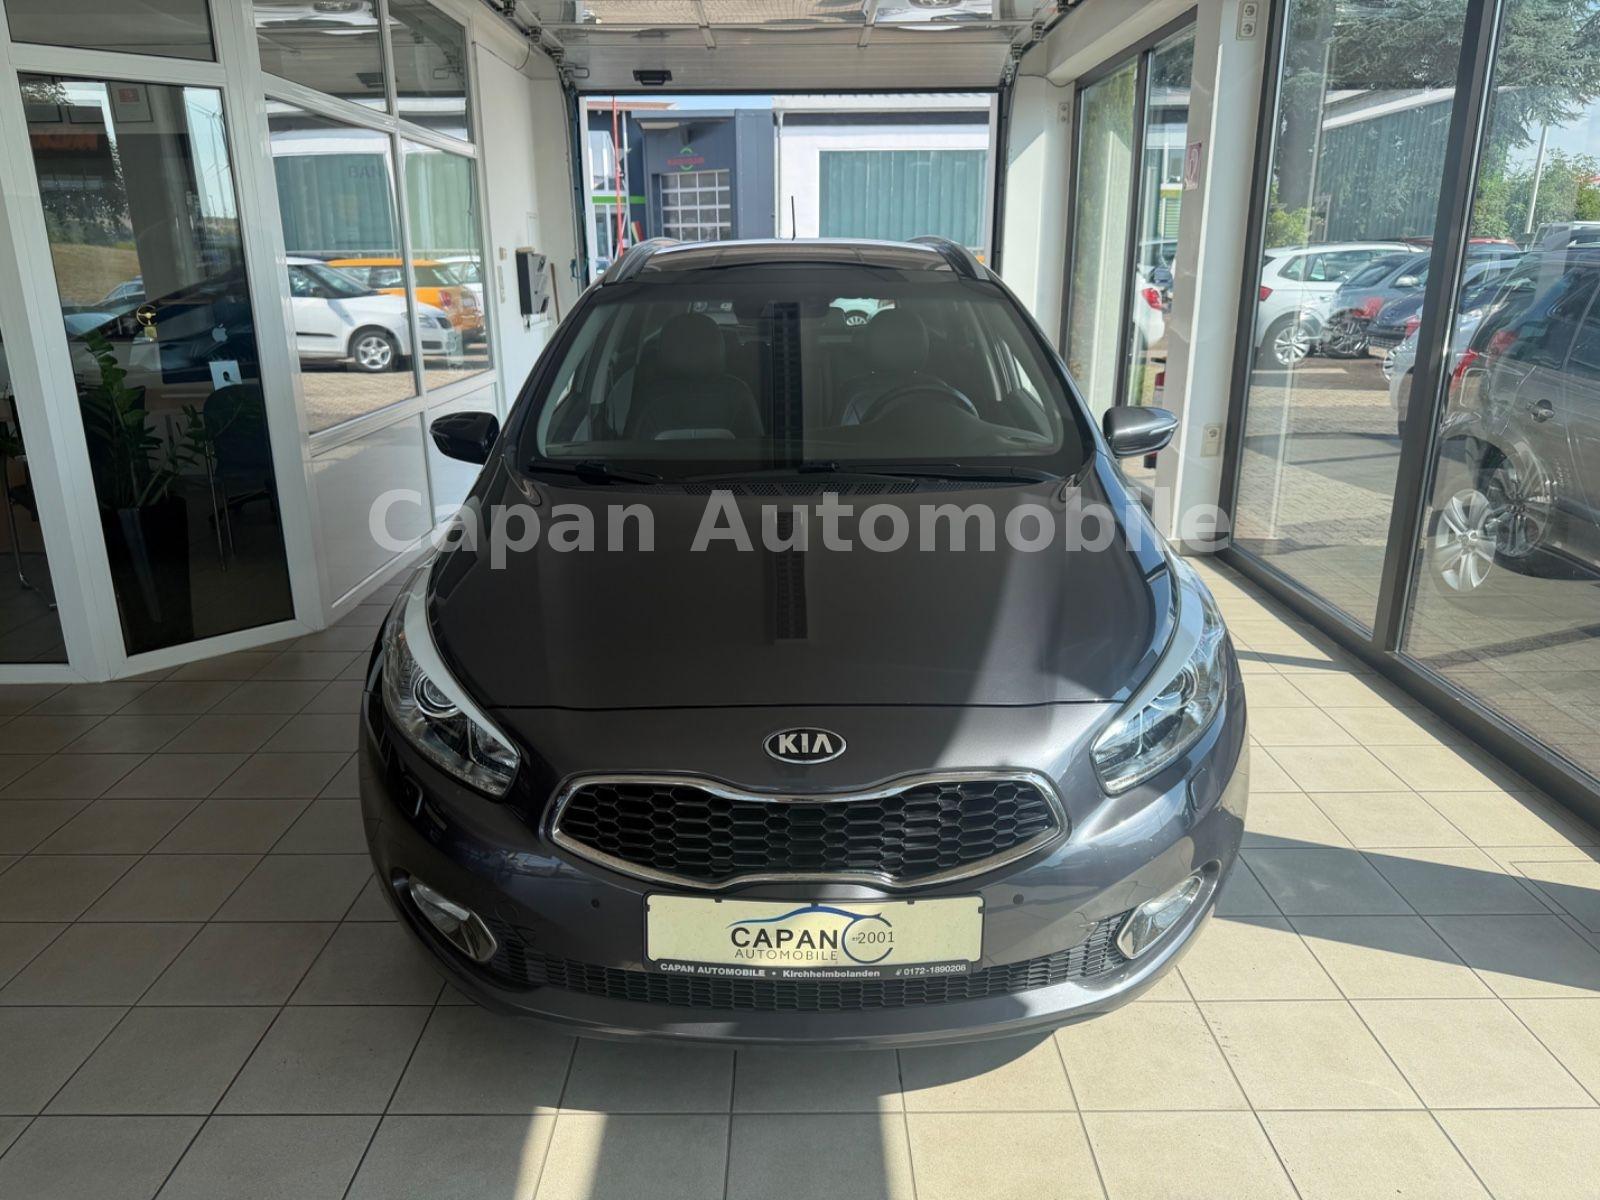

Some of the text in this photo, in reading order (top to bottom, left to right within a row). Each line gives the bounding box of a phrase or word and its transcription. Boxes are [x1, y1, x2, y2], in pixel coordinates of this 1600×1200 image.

[778, 732, 834, 755] KIA
[730, 927, 838, 950] CAPAN
[858, 931, 895, 944] 2001
[734, 948, 838, 961] AUTOMOBILE
[660, 963, 695, 973] CAPAN
[697, 966, 766, 977] AUTOMOBILE
[782, 969, 880, 978] Kirchheimbolanden
